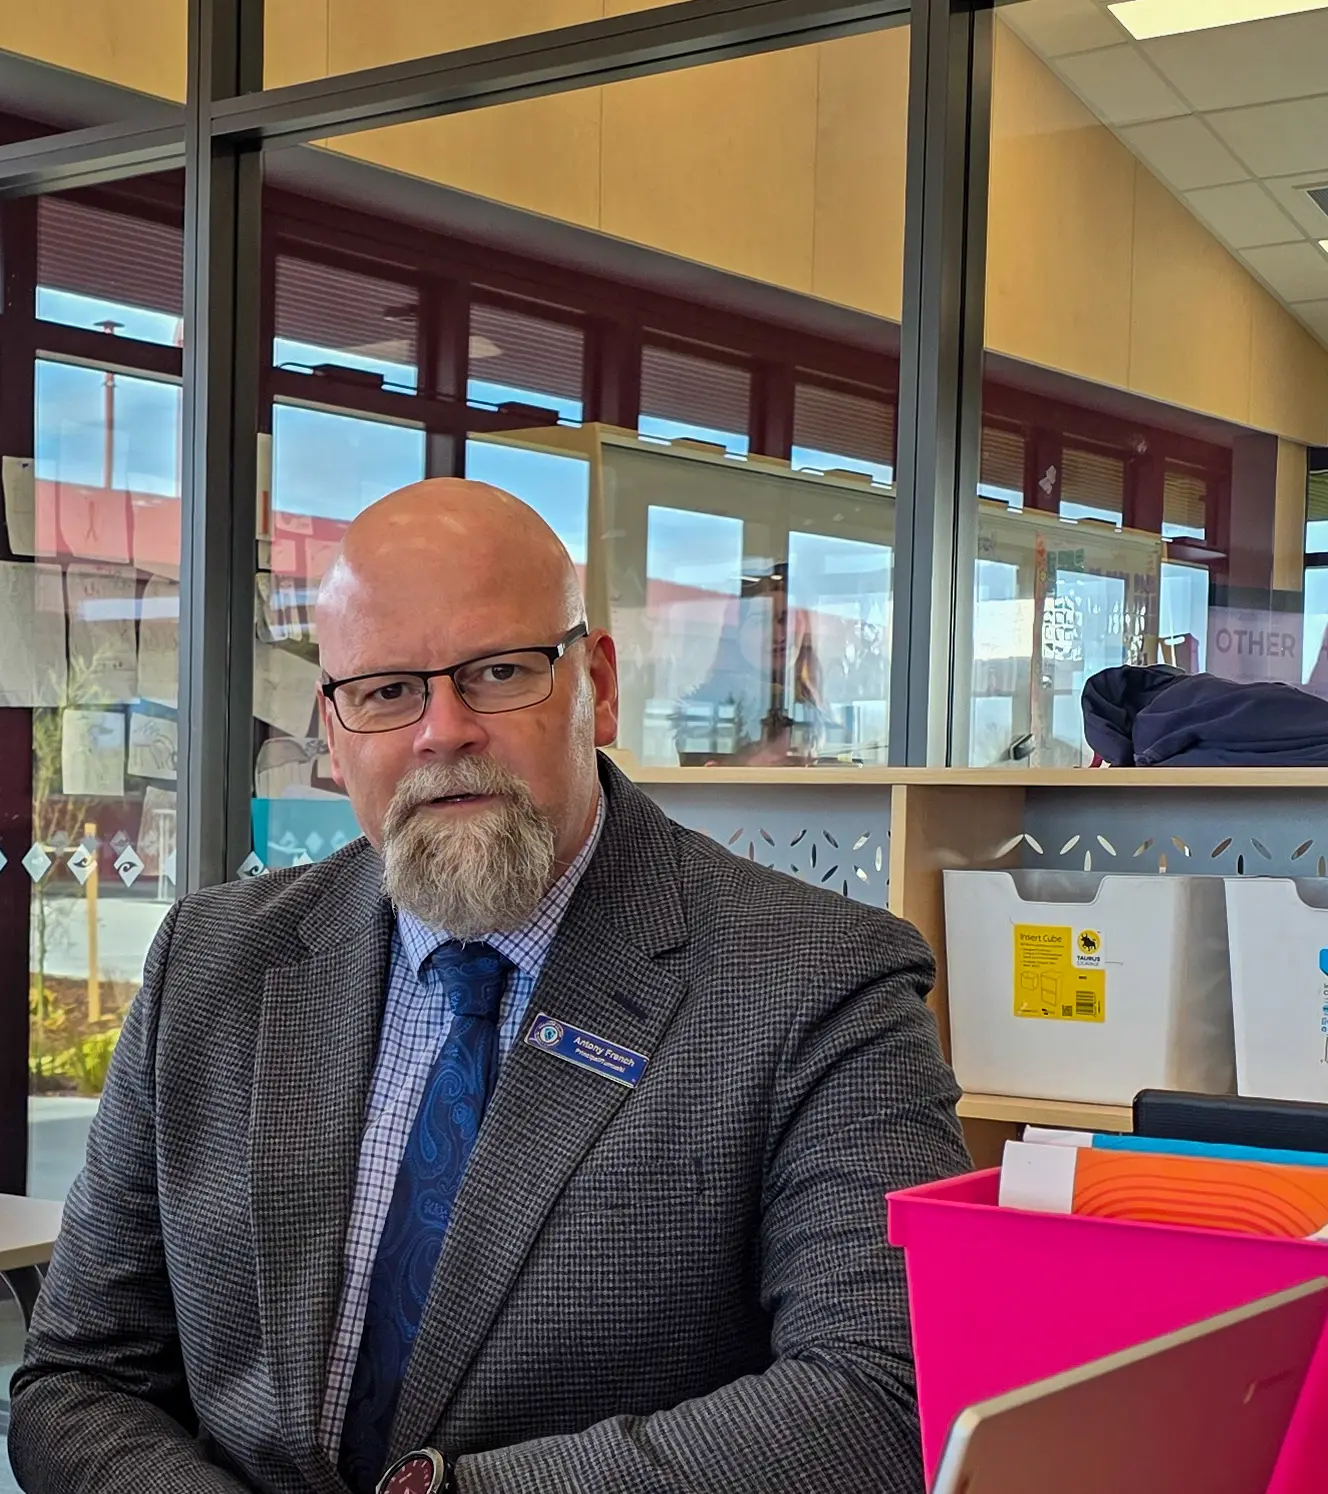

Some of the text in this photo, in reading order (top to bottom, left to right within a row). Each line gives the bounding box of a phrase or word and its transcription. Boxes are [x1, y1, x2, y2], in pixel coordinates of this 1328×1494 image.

[1215, 627, 1296, 659] OTHER
[1020, 932, 1062, 943] Insert Cube
[573, 1036, 635, 1067] Antony French
